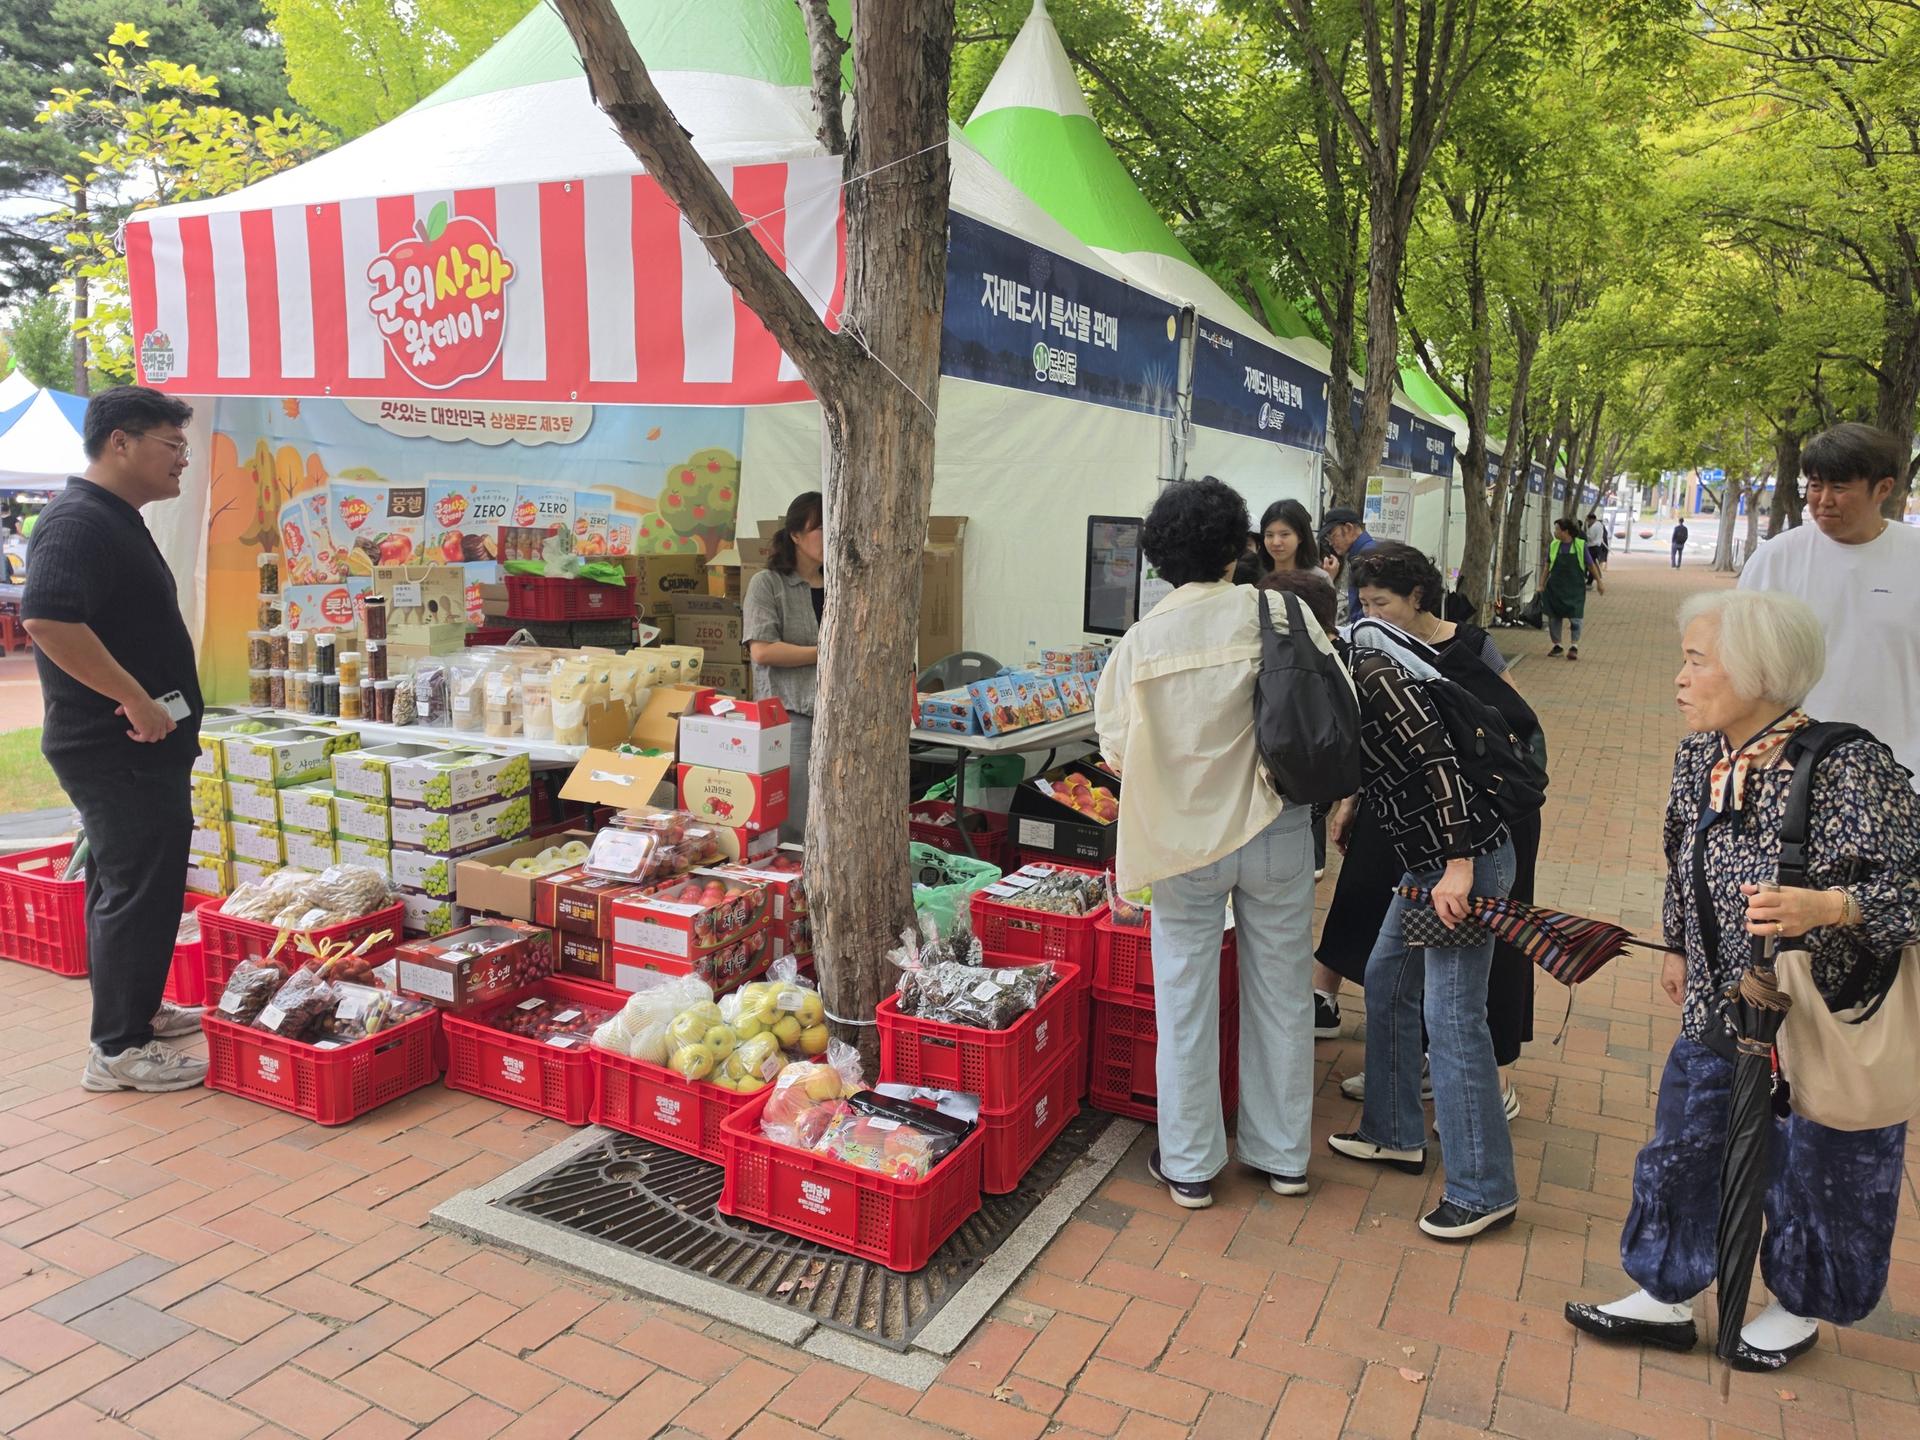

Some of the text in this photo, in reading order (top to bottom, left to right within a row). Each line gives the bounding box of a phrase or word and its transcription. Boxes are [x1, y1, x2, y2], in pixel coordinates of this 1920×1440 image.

[981, 272, 1118, 351] 자매도시 특산물 판매
[1049, 348, 1077, 375] 군위군
[380, 401, 573, 432] 맛있는 대한민국 상생로드 제3탄
[391, 496, 422, 513] 몽쉘
[473, 504, 507, 518] ZERO
[539, 502, 567, 514] ZERO
[696, 627, 723, 639] ZERO
[723, 907, 746, 930] 자두
[724, 953, 747, 974] 자두
